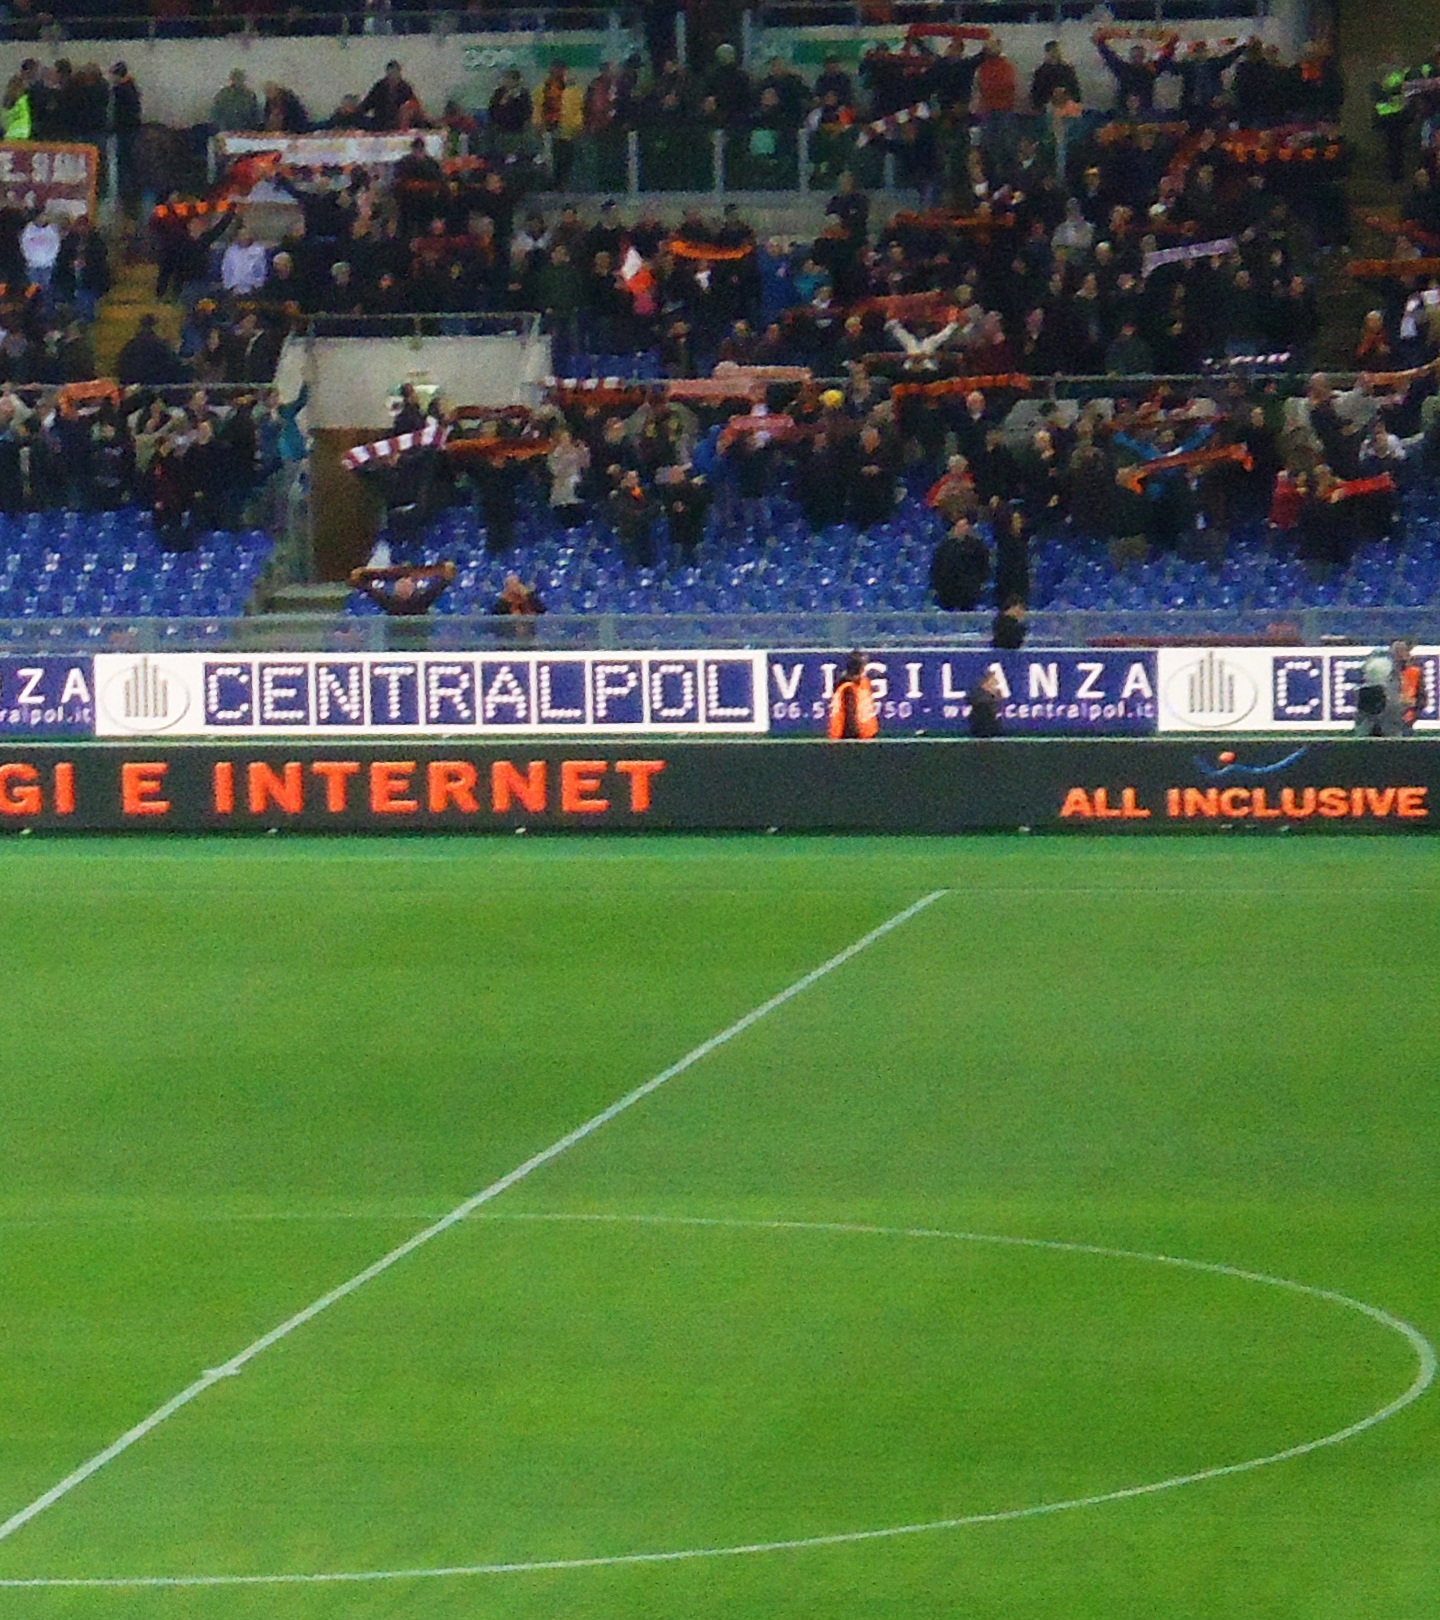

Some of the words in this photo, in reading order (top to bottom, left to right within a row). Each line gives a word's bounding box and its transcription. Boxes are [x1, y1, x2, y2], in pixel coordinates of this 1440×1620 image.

[204, 661, 752, 725] CENTRALPOL
[772, 661, 1154, 699] VIGILANZA
[1275, 658, 1437, 716] CE
[121, 760, 171, 814] E
[214, 759, 667, 814] INTERNET
[1059, 786, 1152, 819] ALL
[1166, 786, 1430, 819] INCLUSIVE
